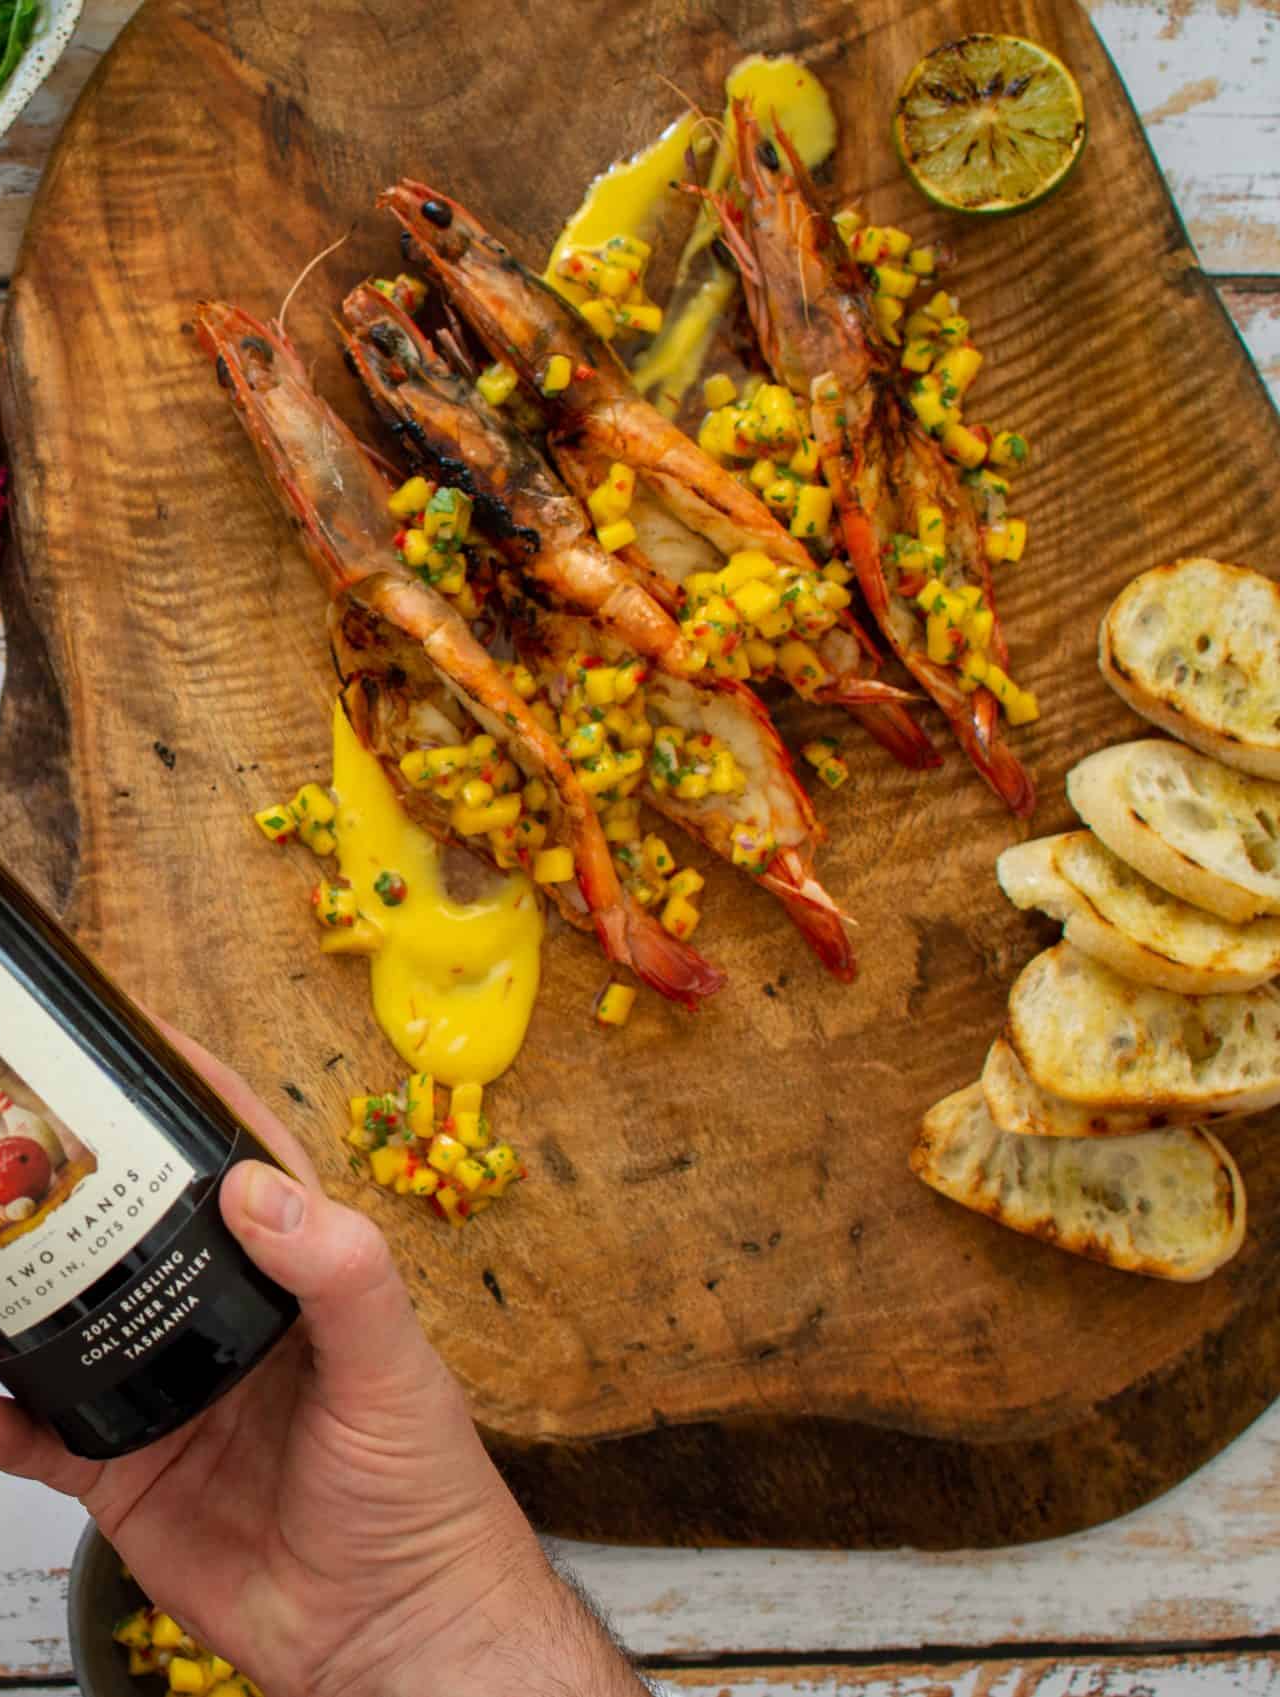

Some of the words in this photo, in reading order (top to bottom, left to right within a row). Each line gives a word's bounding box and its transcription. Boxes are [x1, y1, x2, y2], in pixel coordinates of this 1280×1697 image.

[6, 1250, 55, 1288] TWO
[66, 1168, 141, 1243] HANDS
[35, 1279, 55, 1297] OF
[60, 1260, 86, 1279] IN,
[88, 1223, 124, 1256] LOTS
[127, 1197, 145, 1218] OF
[149, 1162, 175, 1193] OUT
[80, 1336, 120, 1366] COAL
[121, 1300, 165, 1338] RIVER
[164, 1247, 212, 1299] VALLEY
[81, 1312, 118, 1342] 2021
[120, 1250, 185, 1312] RIESLING
[122, 1294, 200, 1360] TASMANIA
